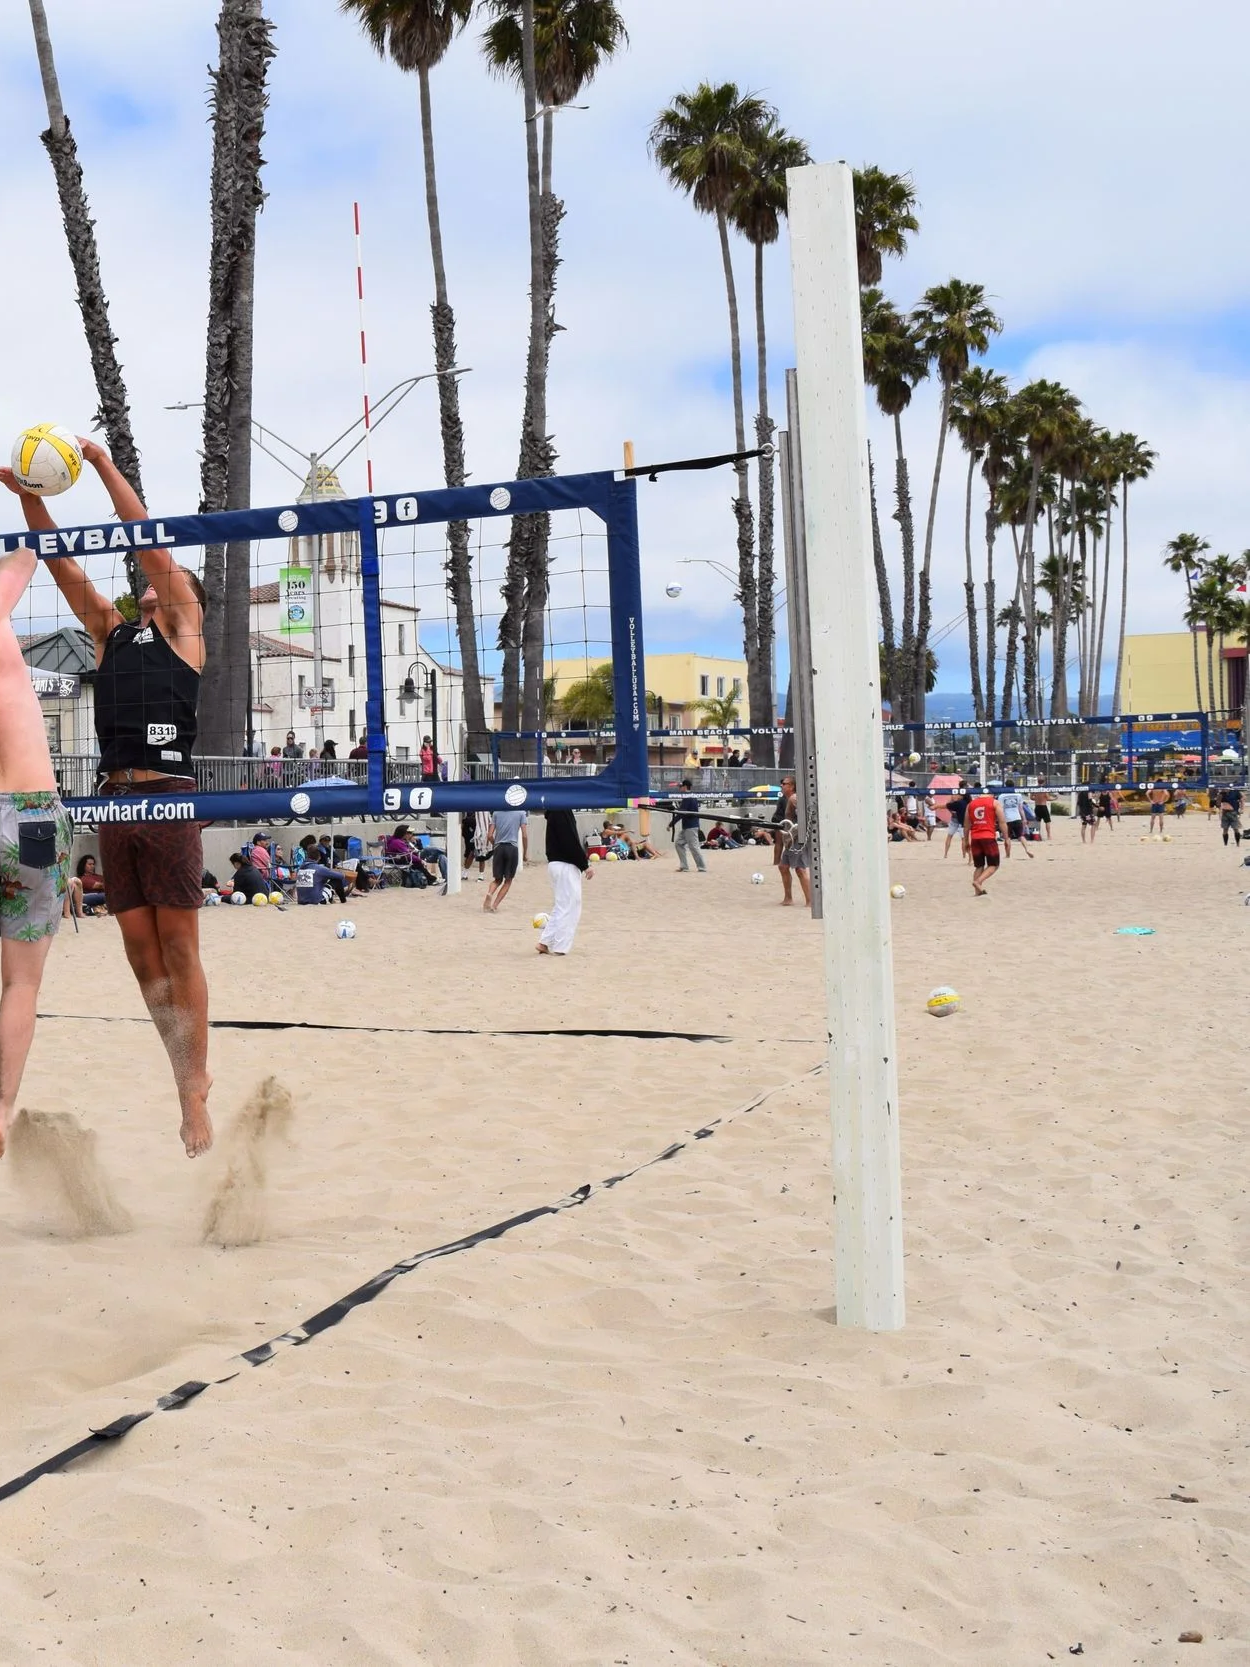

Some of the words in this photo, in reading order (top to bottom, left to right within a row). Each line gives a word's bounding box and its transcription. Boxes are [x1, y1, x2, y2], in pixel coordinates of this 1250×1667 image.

[955, 721, 992, 729] BEACH
[1015, 717, 1086, 726] VOLLEYBALL
[66, 799, 195, 822] ruzwharf.com
